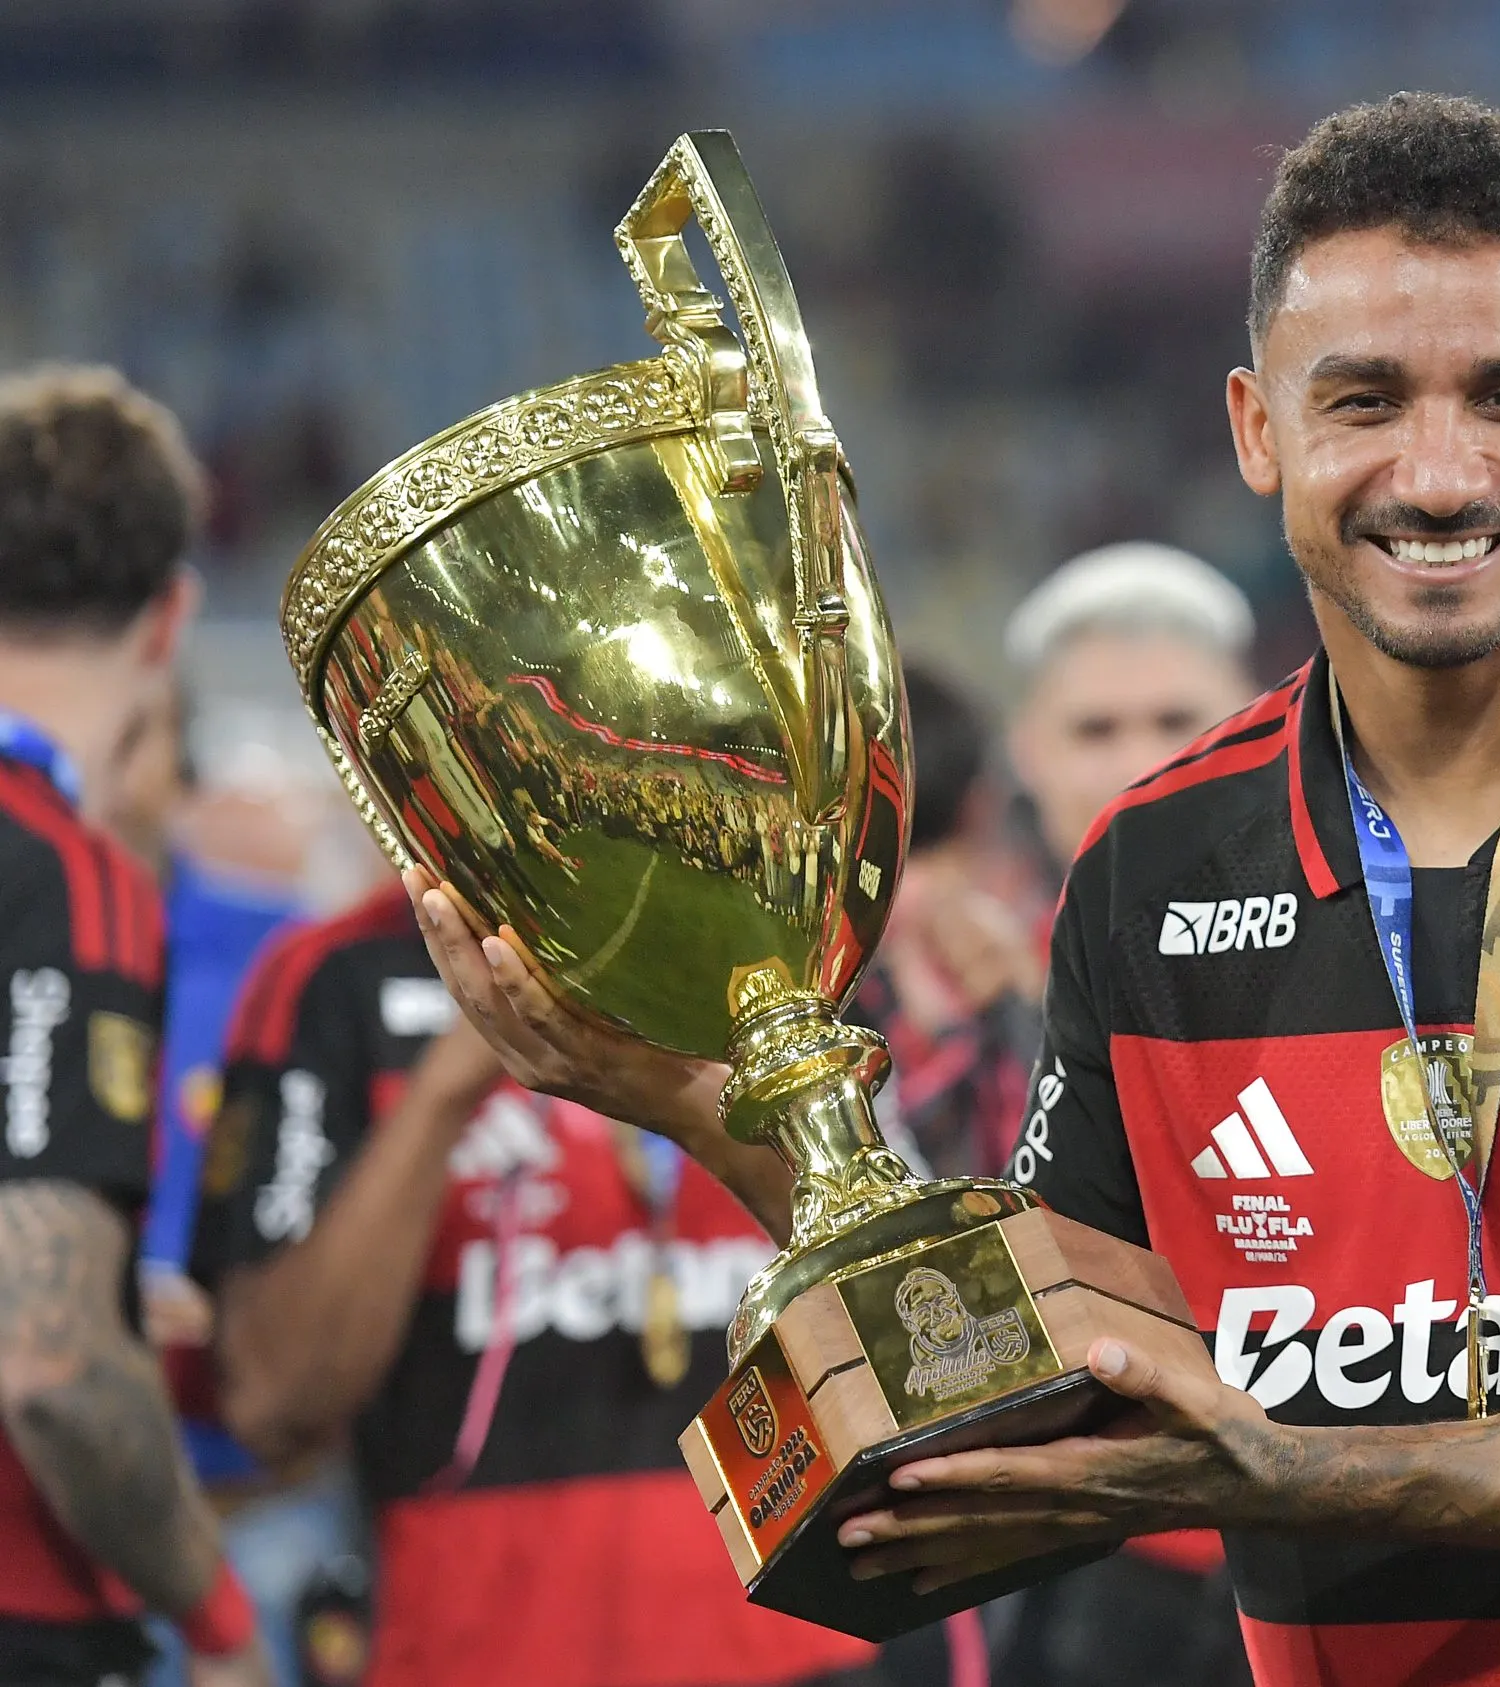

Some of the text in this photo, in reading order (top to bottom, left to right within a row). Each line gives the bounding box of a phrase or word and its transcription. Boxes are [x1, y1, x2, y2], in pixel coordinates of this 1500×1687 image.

[1353, 769, 1391, 838] ERJ
[1208, 893, 1298, 954] BRB
[1391, 1038, 1468, 1062] CAMPEÓ
[1010, 1055, 1067, 1188] ope
[1232, 1195, 1291, 1211] FINAL
[1216, 1214, 1314, 1236] FLU FLA
[729, 1374, 758, 1415] FERJ
[779, 1424, 808, 1463] 2026
[750, 1440, 820, 1528] CARIOCA
[773, 1478, 808, 1522] SUPERBET
